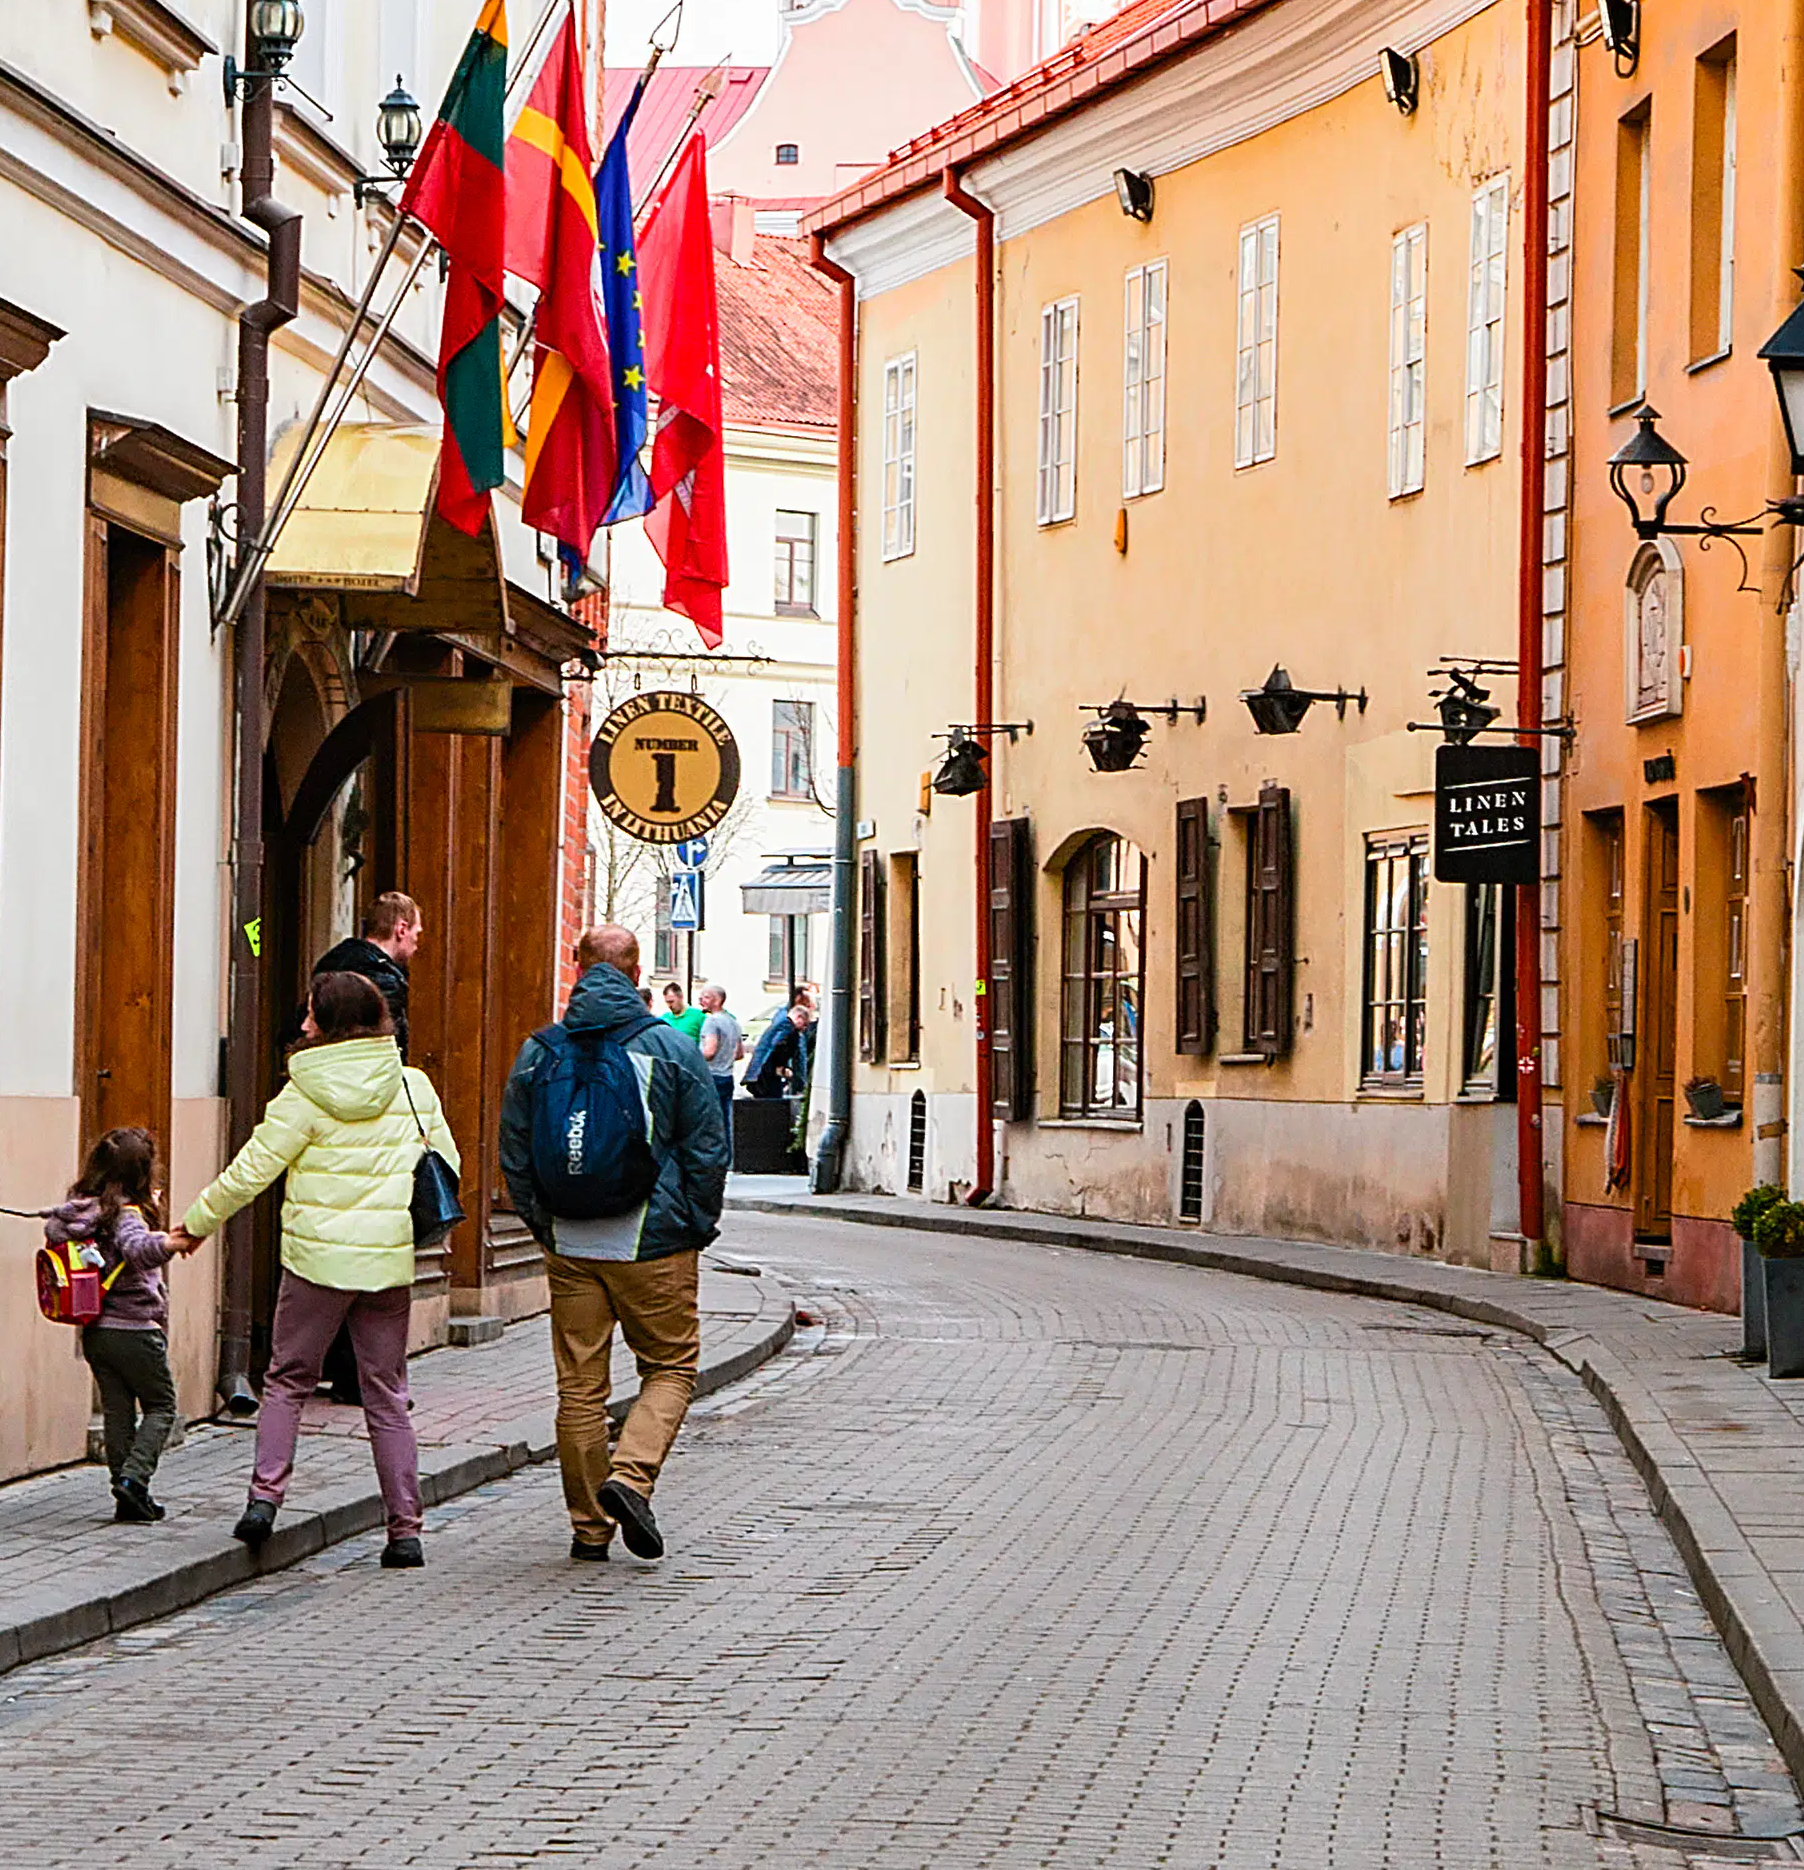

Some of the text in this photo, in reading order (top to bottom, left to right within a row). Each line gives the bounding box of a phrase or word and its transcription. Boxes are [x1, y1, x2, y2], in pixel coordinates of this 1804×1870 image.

[597, 693, 732, 746] LINEN TEXTILE
[634, 737, 699, 752] NUMBER
[649, 752, 682, 813] 1
[1449, 791, 1527, 813] LINEN
[620, 799, 729, 842] LITHUANIA
[1449, 816, 1525, 838] TALES
[567, 1110, 587, 1175] Reebok
